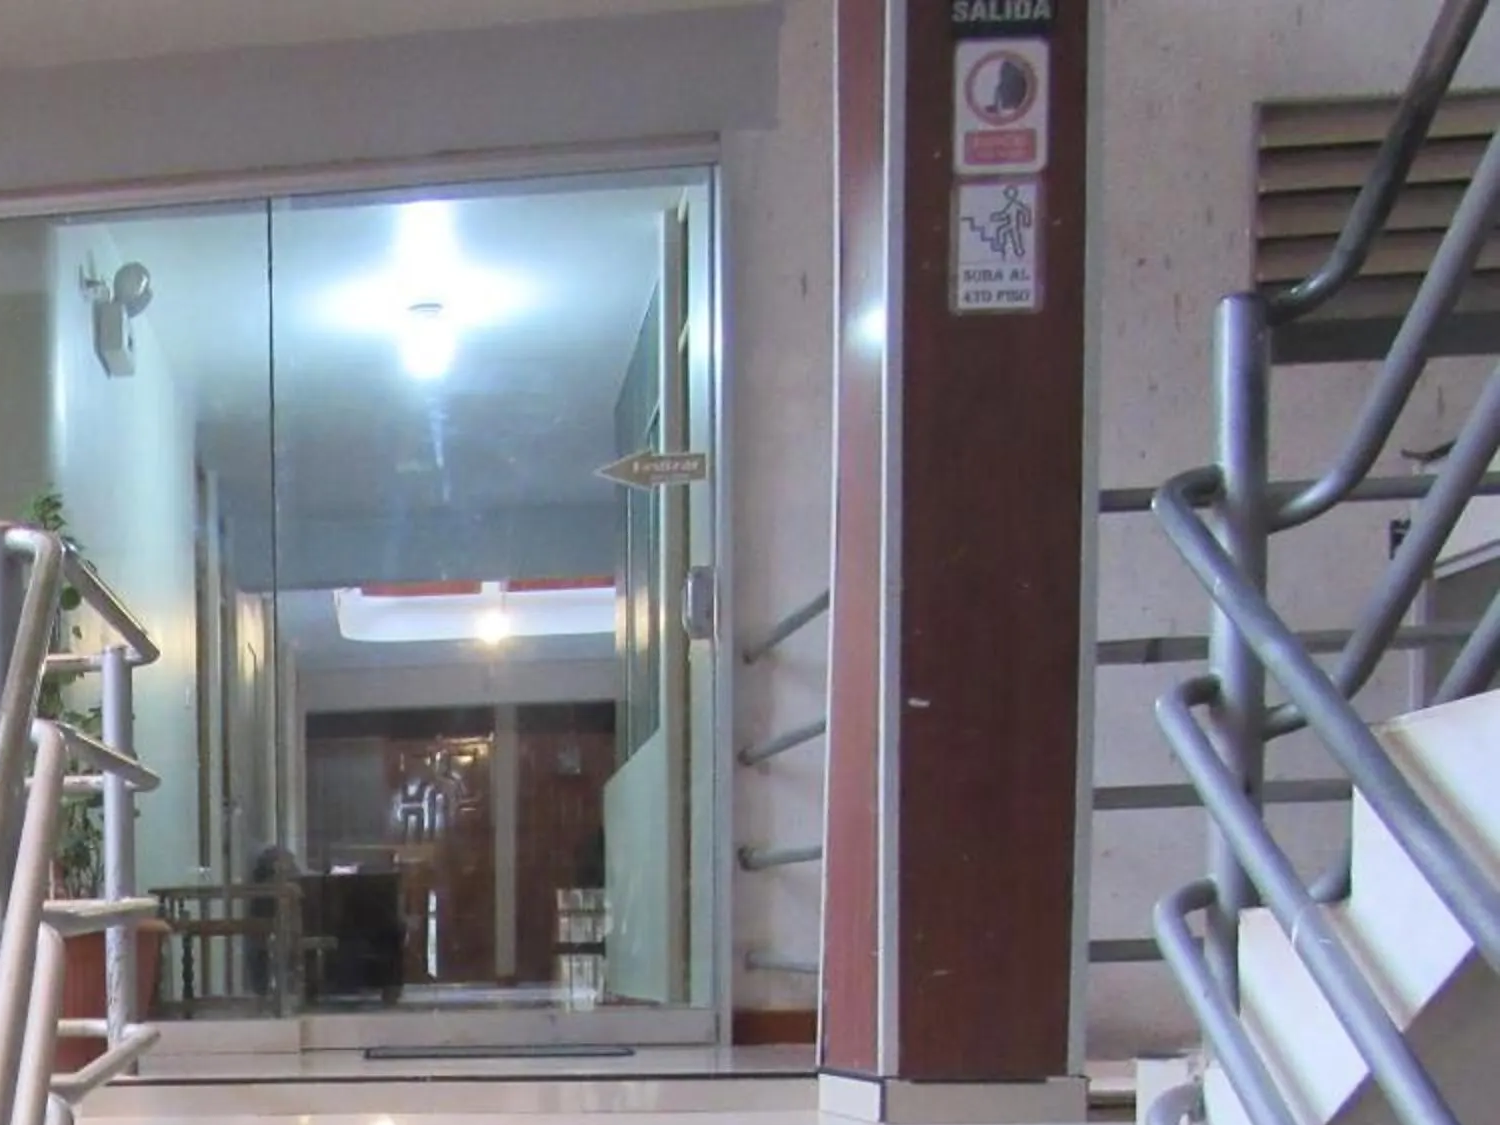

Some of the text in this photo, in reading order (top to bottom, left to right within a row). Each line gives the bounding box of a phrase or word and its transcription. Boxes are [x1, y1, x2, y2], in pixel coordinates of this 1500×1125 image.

[951, 0, 1052, 22] SALIDA
[963, 267, 1032, 282] SUBA AL
[995, 288, 1032, 303] PISO
